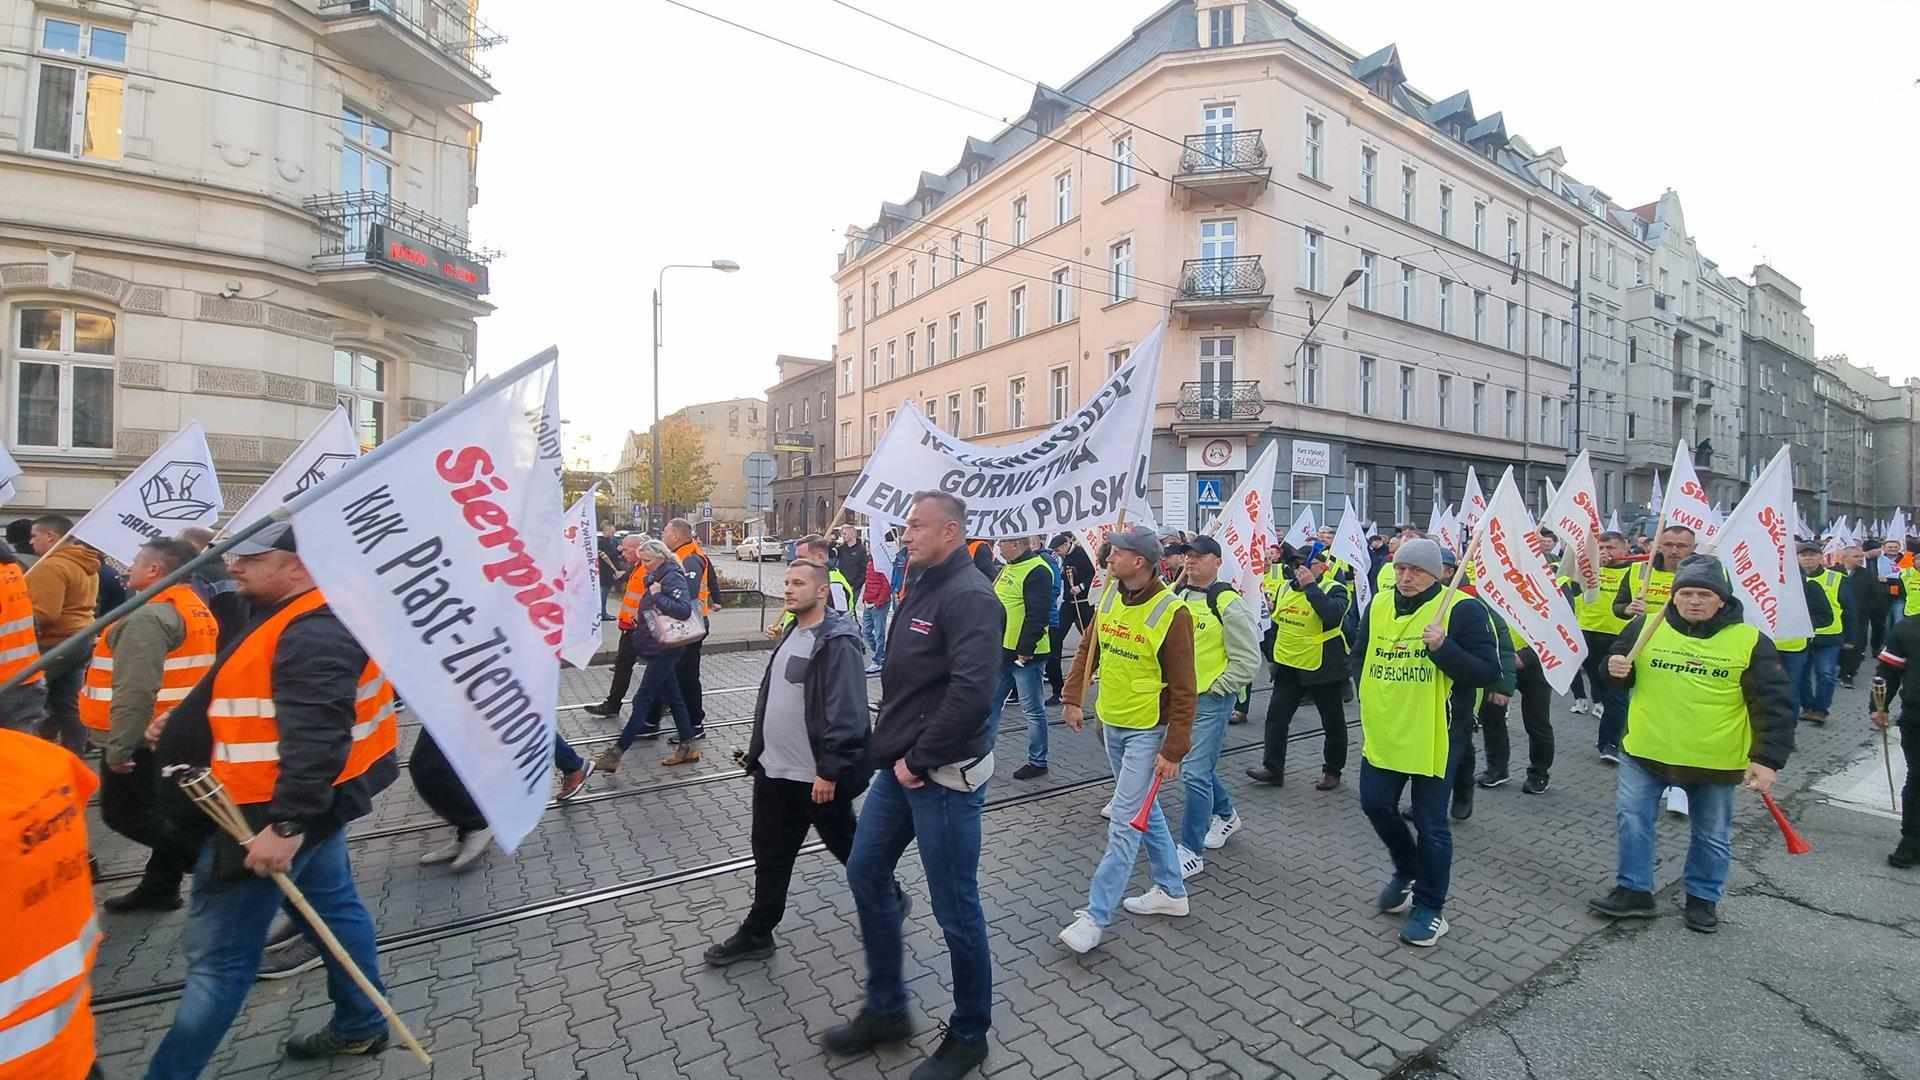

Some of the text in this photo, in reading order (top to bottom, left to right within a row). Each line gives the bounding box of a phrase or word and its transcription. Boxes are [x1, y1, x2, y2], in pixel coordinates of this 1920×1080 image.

[940, 436, 1100, 499] GÓRNICTWA
[342, 484, 408, 555] KWK
[1672, 508, 1704, 531] KWB
[1375, 647, 1427, 661] Sirpień 80
[1384, 664, 1434, 683] BEŁCHATÓW
[1650, 658, 1729, 678] Sierpień 80
